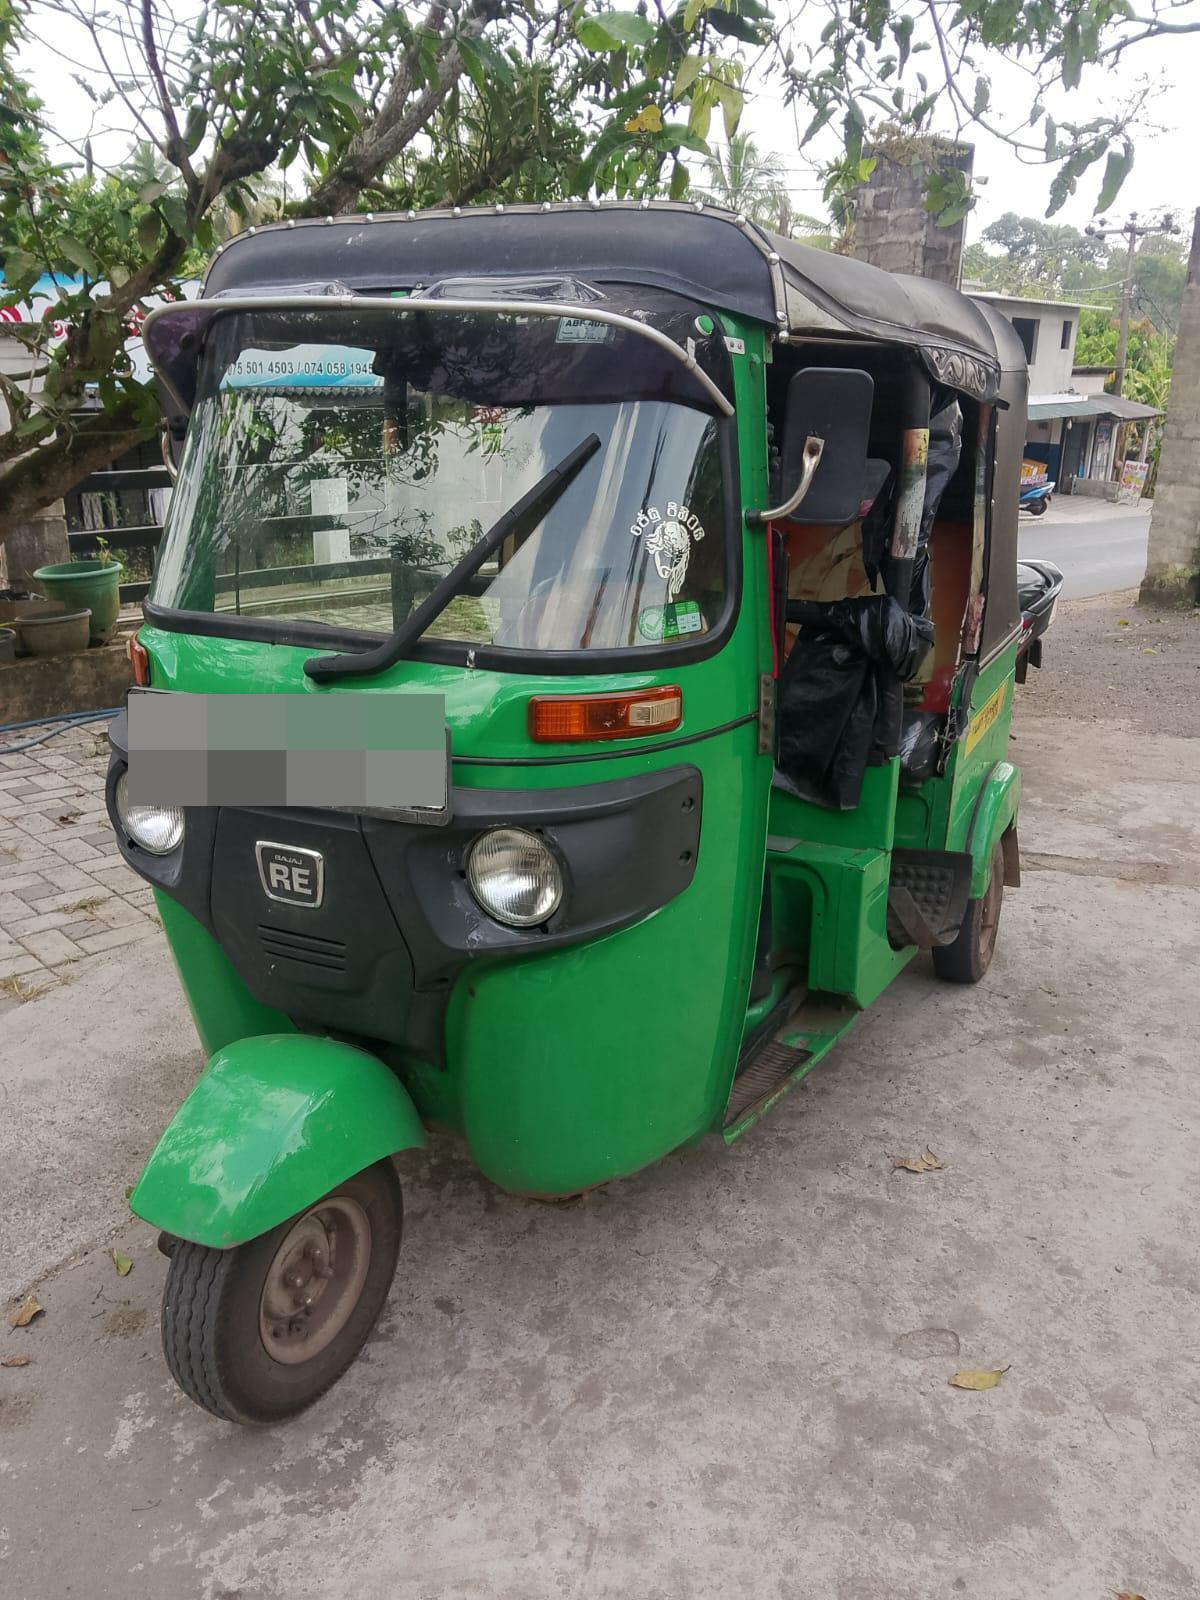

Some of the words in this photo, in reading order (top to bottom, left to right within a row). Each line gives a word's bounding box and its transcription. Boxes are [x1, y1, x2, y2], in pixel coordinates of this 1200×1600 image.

[246, 361, 264, 374] 501
[268, 361, 294, 374] 4503
[304, 362, 323, 375] 074
[327, 362, 346, 375] 058
[274, 854, 303, 865] BAJAJ
[269, 862, 312, 895] RE
